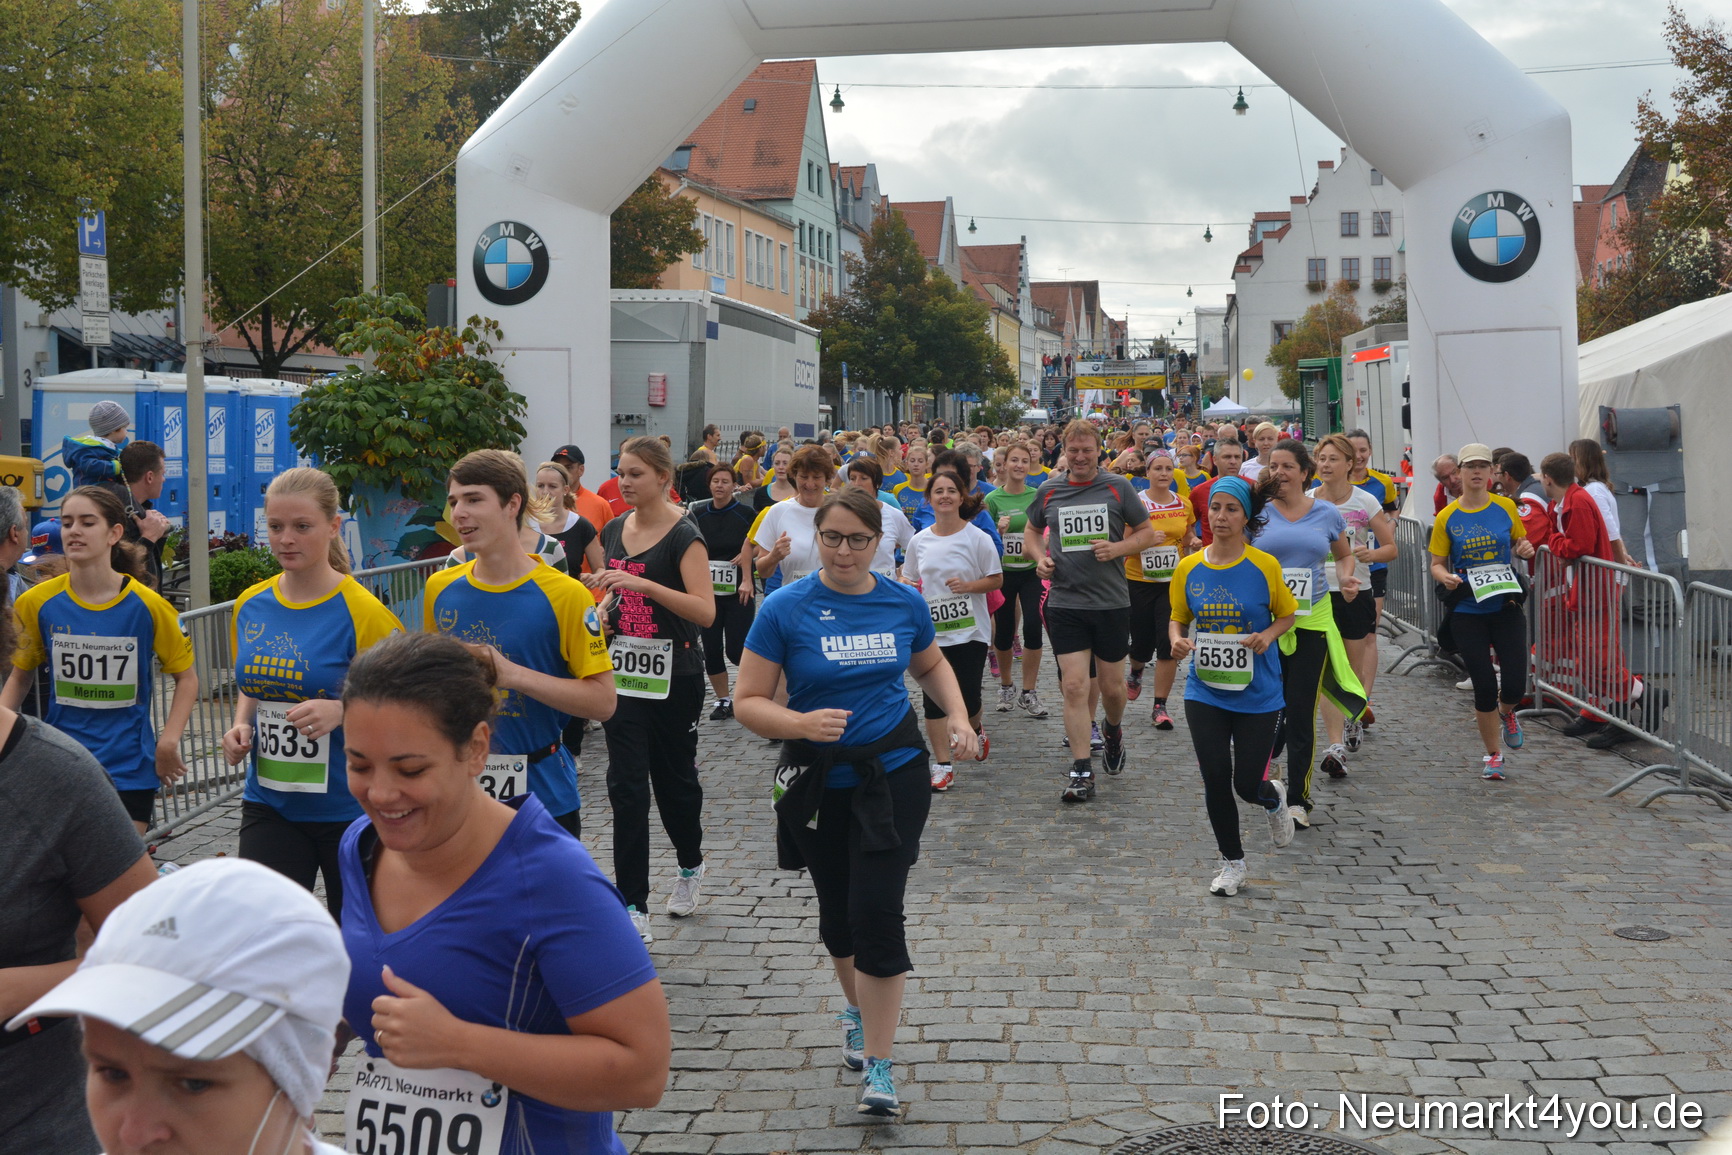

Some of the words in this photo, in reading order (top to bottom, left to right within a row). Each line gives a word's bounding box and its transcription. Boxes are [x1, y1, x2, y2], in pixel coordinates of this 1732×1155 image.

[1458, 193, 1534, 224] BMW
[478, 223, 542, 250] BMW
[82, 269, 106, 278] Parkschein
[24, 369, 32, 388] 3
[795, 359, 815, 390] BOCK
[1104, 378, 1136, 386] START
[1064, 515, 1104, 534] 5019
[1006, 542, 1022, 554] 50
[1146, 554, 1176, 570] 5047
[710, 569, 732, 582] 115
[1286, 579, 1308, 597] 27
[930, 601, 968, 622] 5033
[54, 640, 80, 650] PARTL
[82, 643, 122, 651] Neumarkt
[630, 642, 660, 650] Neumarkt
[820, 632, 896, 652] HUBER
[612, 650, 665, 676] 5096
[839, 650, 894, 658] TECHNOLOGY
[1200, 646, 1248, 668] 5538
[62, 652, 129, 680] 5017
[74, 686, 114, 698] Merima
[260, 722, 320, 758] 5533
[484, 763, 510, 771] markt
[480, 775, 516, 800] 34
[356, 1071, 393, 1092] PARTL
[395, 1078, 474, 1104] Neumarkt
[356, 1098, 482, 1155] 5509
